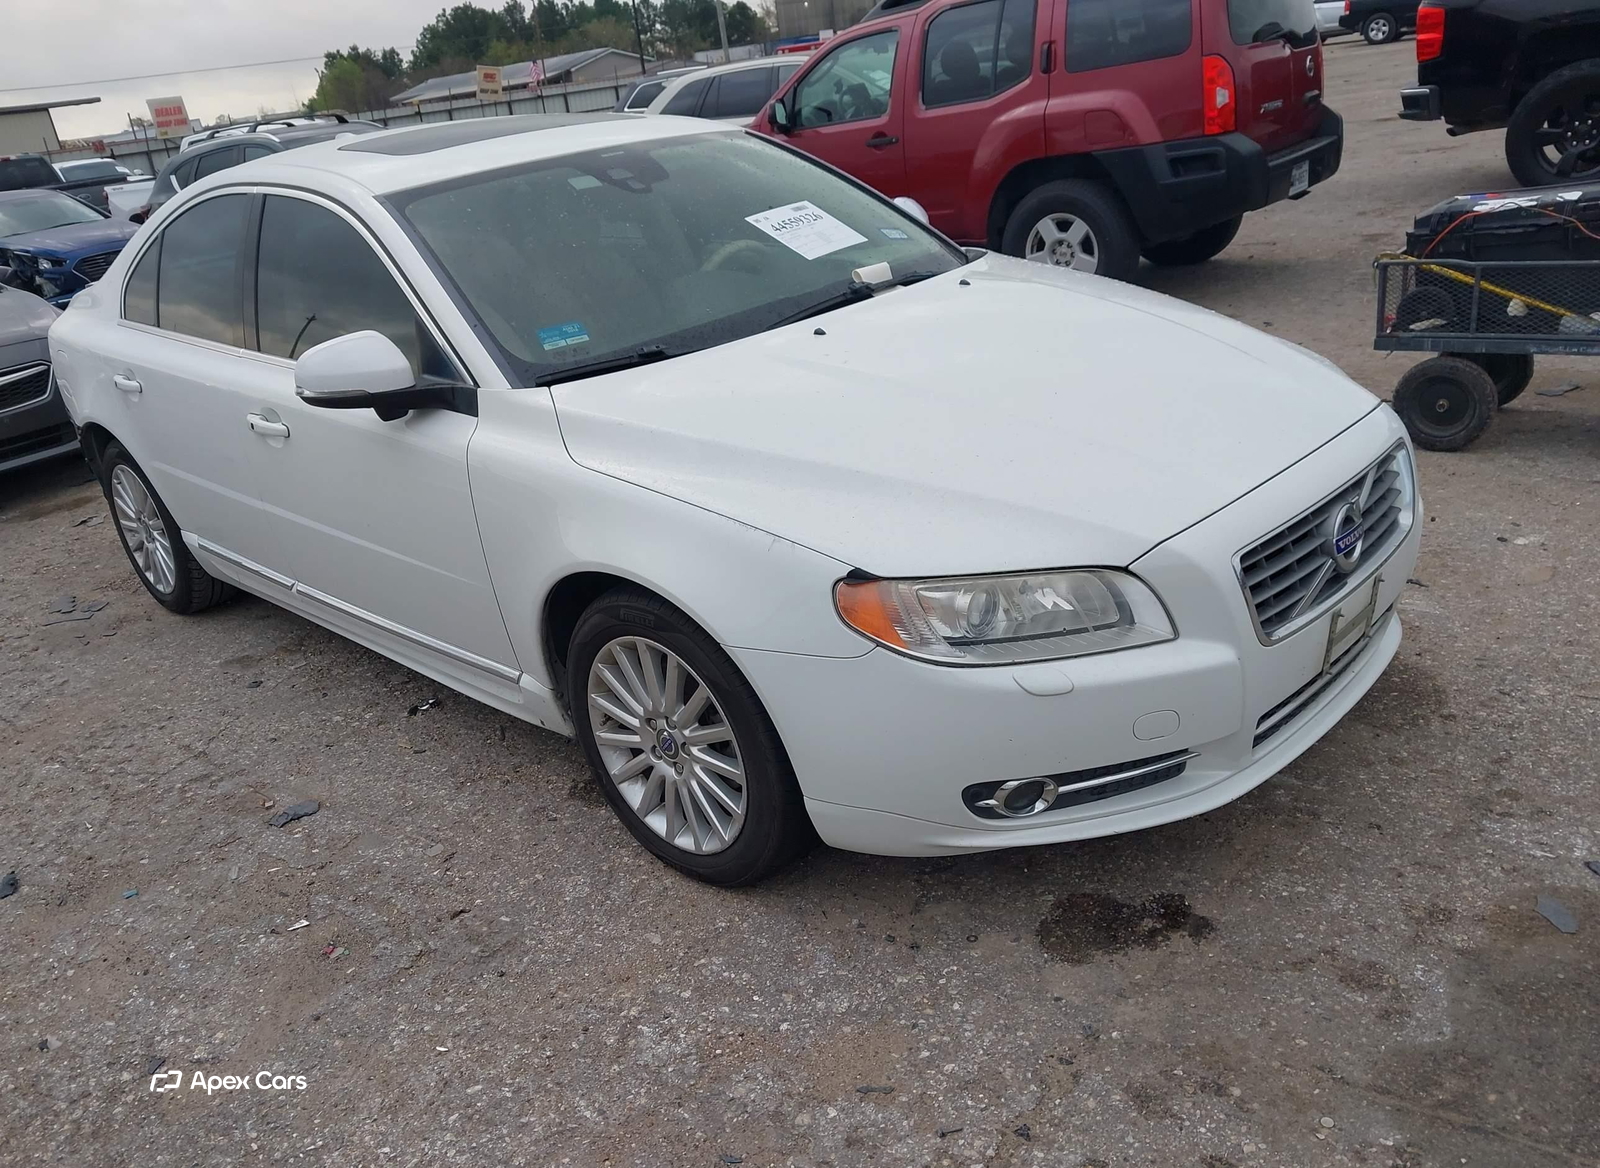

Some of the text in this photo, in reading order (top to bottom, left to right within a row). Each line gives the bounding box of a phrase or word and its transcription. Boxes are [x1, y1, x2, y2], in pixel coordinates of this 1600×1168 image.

[154, 105, 183, 118] DEALER
[770, 211, 824, 233] 44559326
[620, 608, 655, 628] PIRELLI
